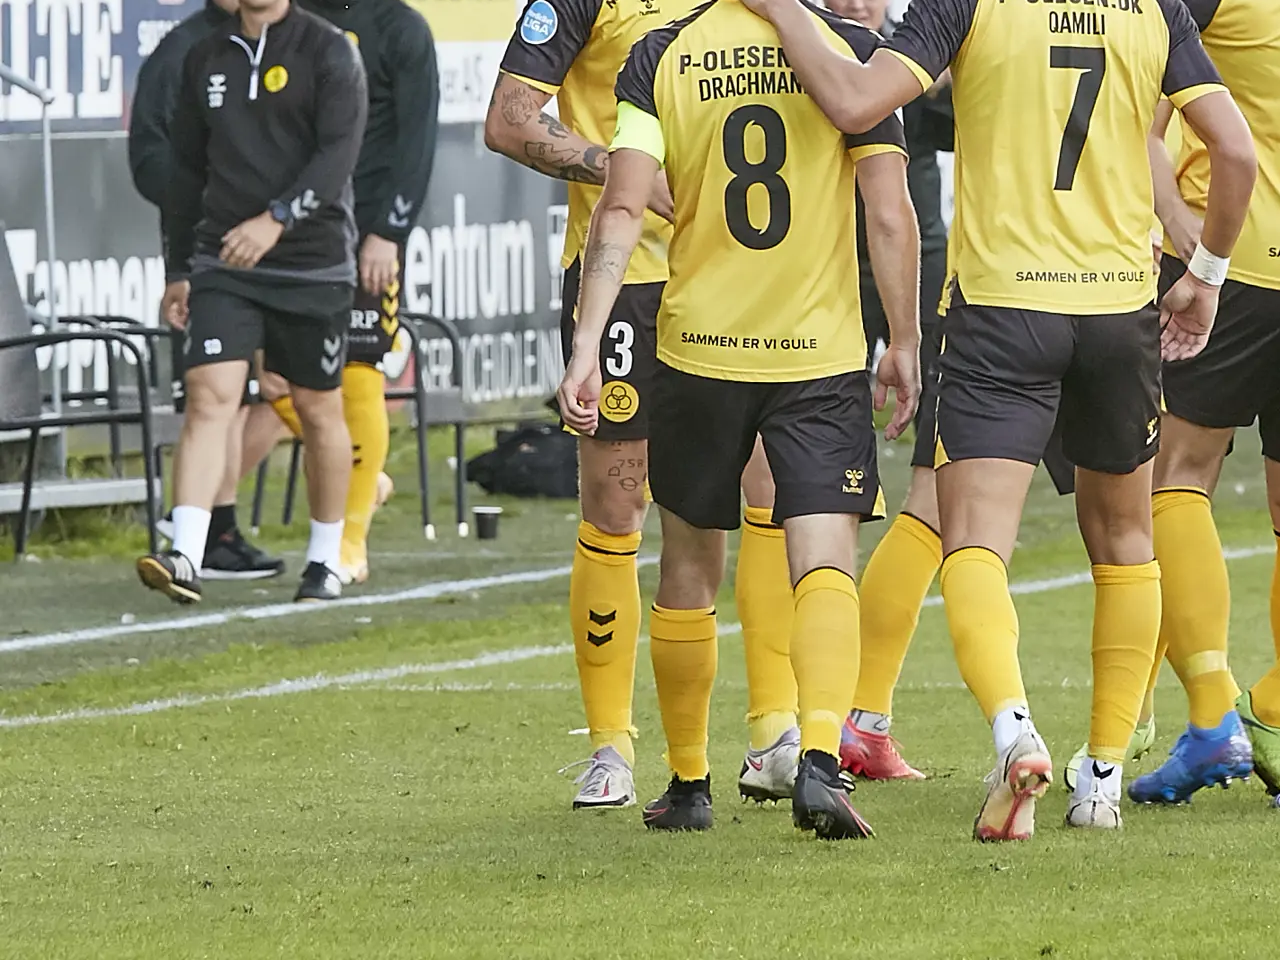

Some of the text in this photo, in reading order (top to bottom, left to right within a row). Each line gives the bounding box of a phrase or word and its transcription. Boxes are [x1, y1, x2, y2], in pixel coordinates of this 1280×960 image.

[522, 16, 549, 36] LIGA
[1048, 10, 1107, 36] QAMILI
[679, 44, 792, 75] P-OLESEN
[698, 70, 808, 103] DRACHMAN
[1049, 45, 1107, 191] 7
[722, 103, 792, 251] 8
[404, 193, 536, 320] entrum
[1015, 270, 1145, 283] SAMMEN ER VI GULE
[605, 320, 635, 378] 3
[680, 331, 818, 350] SAMMEN ER VI GULE
